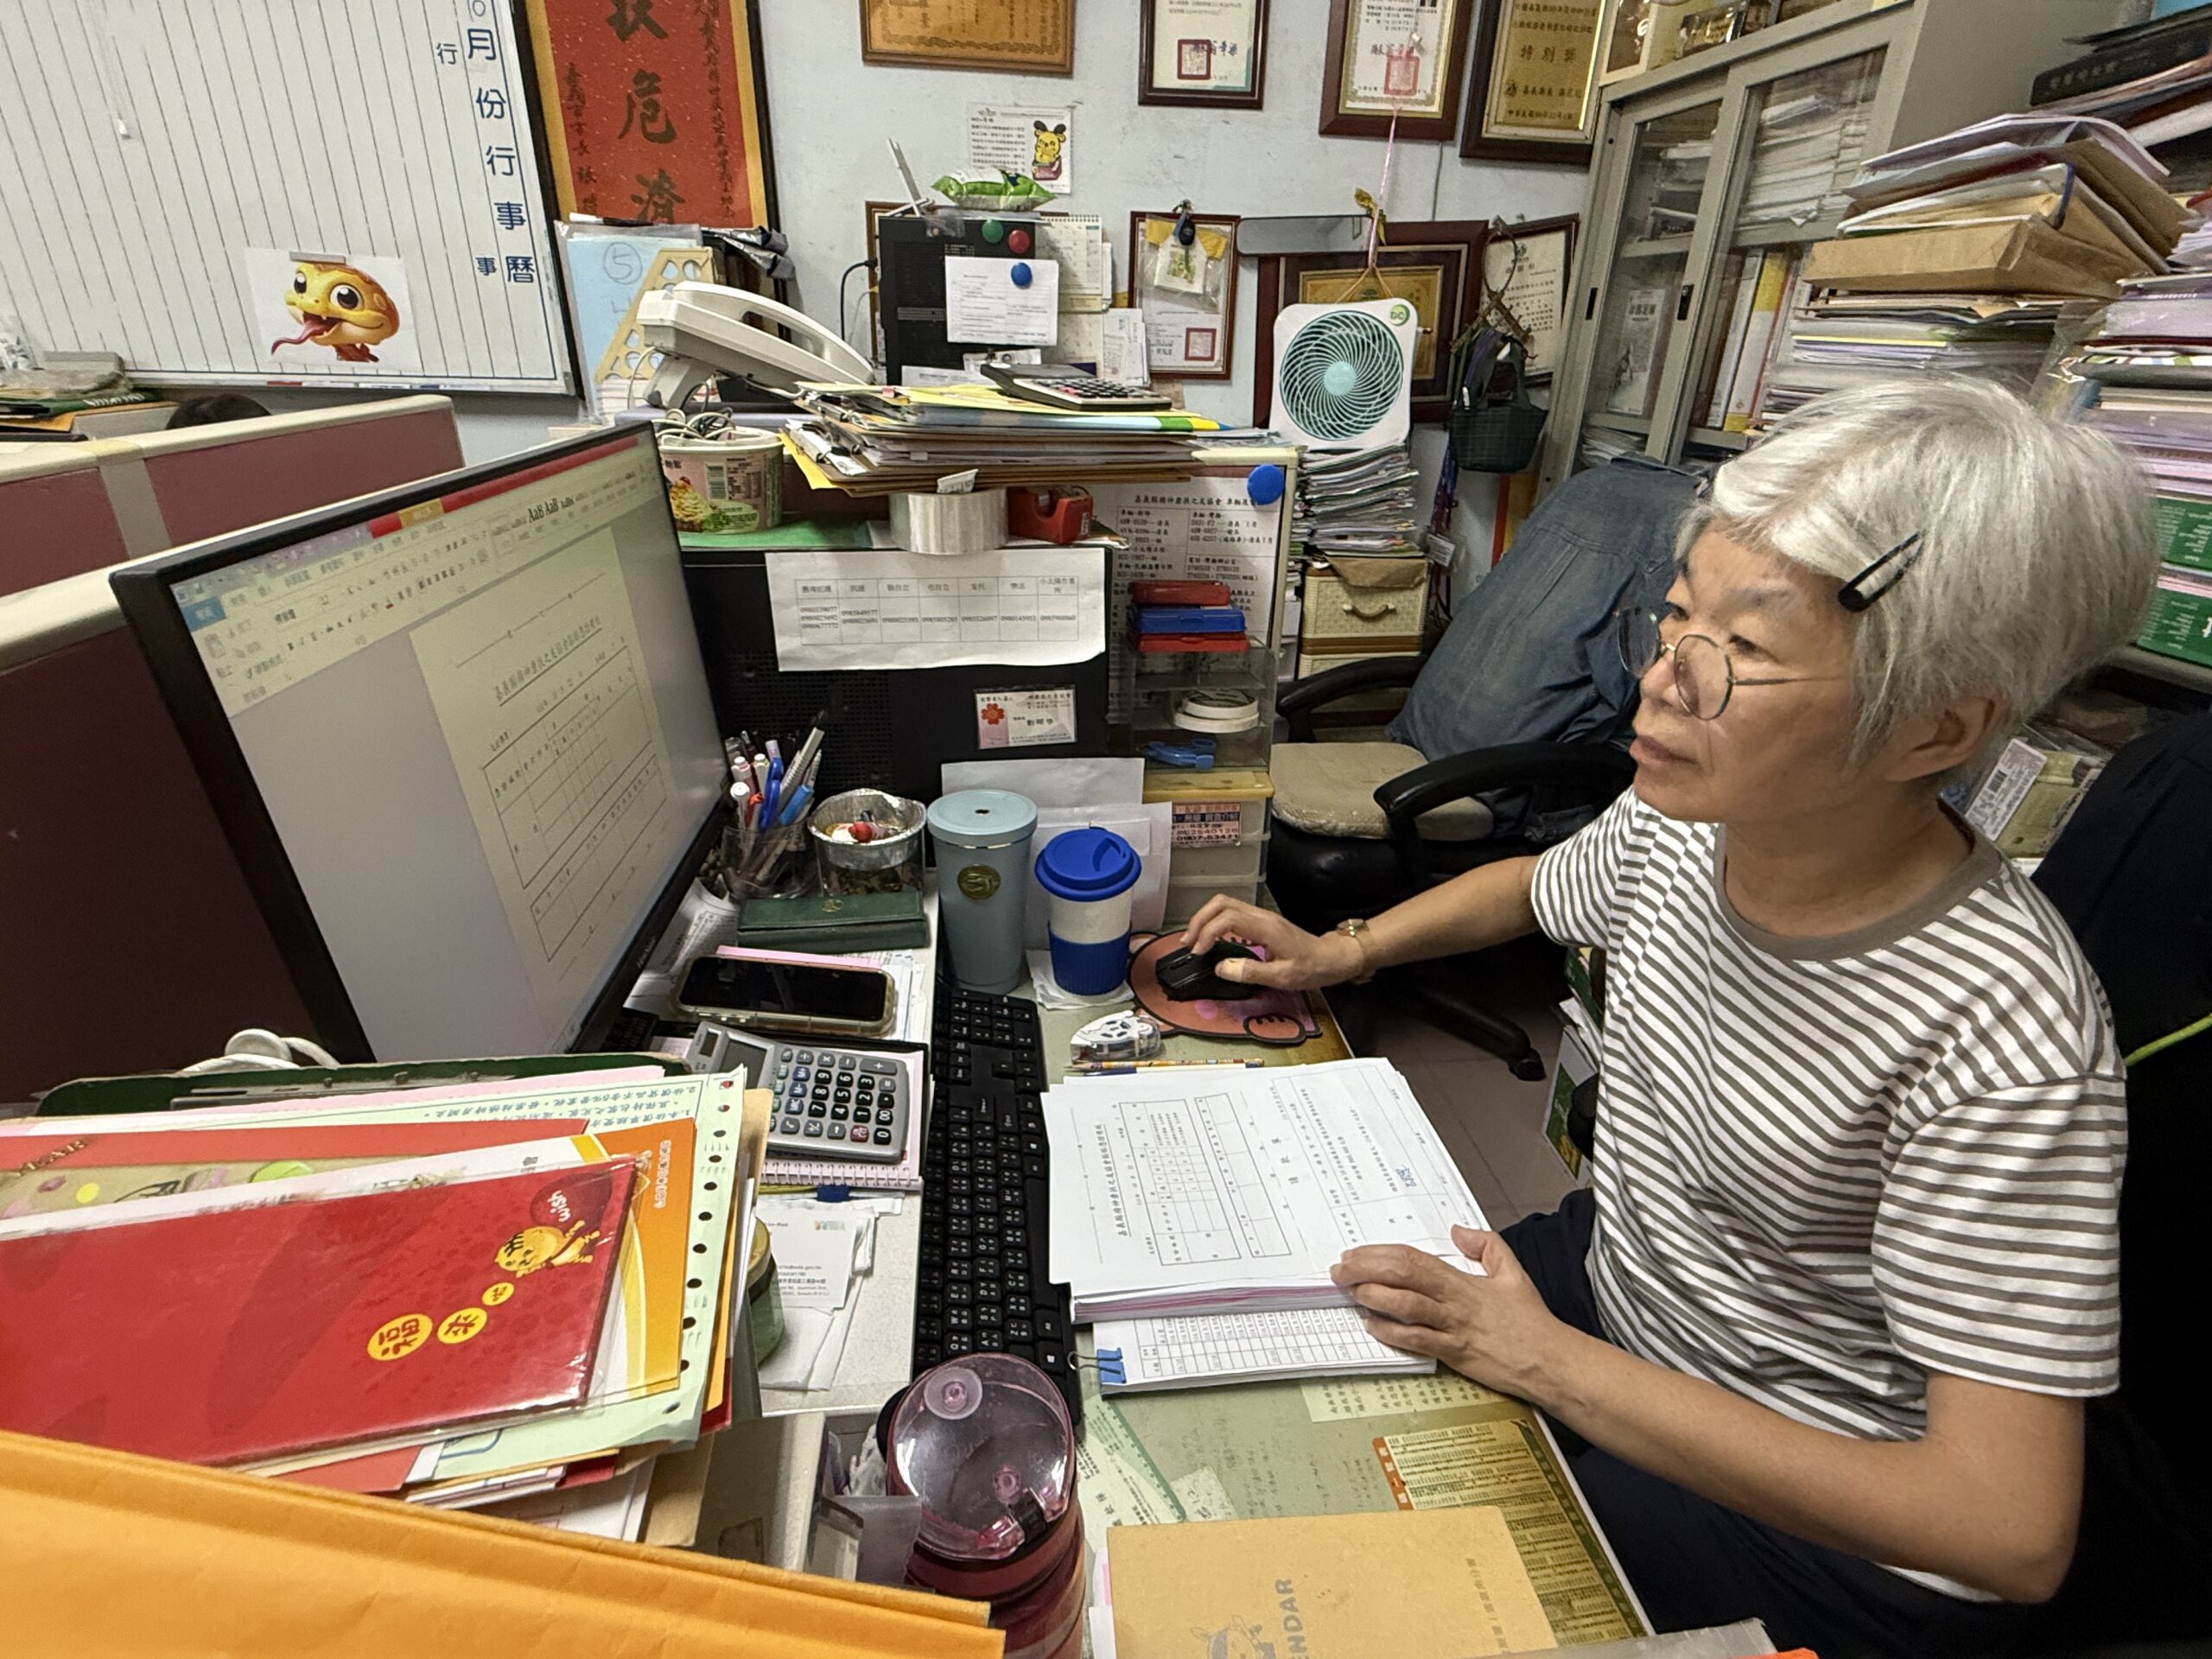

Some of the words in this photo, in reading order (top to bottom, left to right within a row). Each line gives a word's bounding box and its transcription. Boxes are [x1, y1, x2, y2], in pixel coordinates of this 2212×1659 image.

[436, 42, 458, 65] 行
[475, 257, 497, 276] 事
[467, 28, 535, 283] 月份行事曆
[1390, 308, 1406, 322] DC
[878, 1110, 891, 1121] 00
[1271, 1137, 1299, 1185] 請款單
[547, 1190, 571, 1223] wish
[378, 1317, 421, 1357] 福
[1274, 1578, 1307, 1659] NDAR
